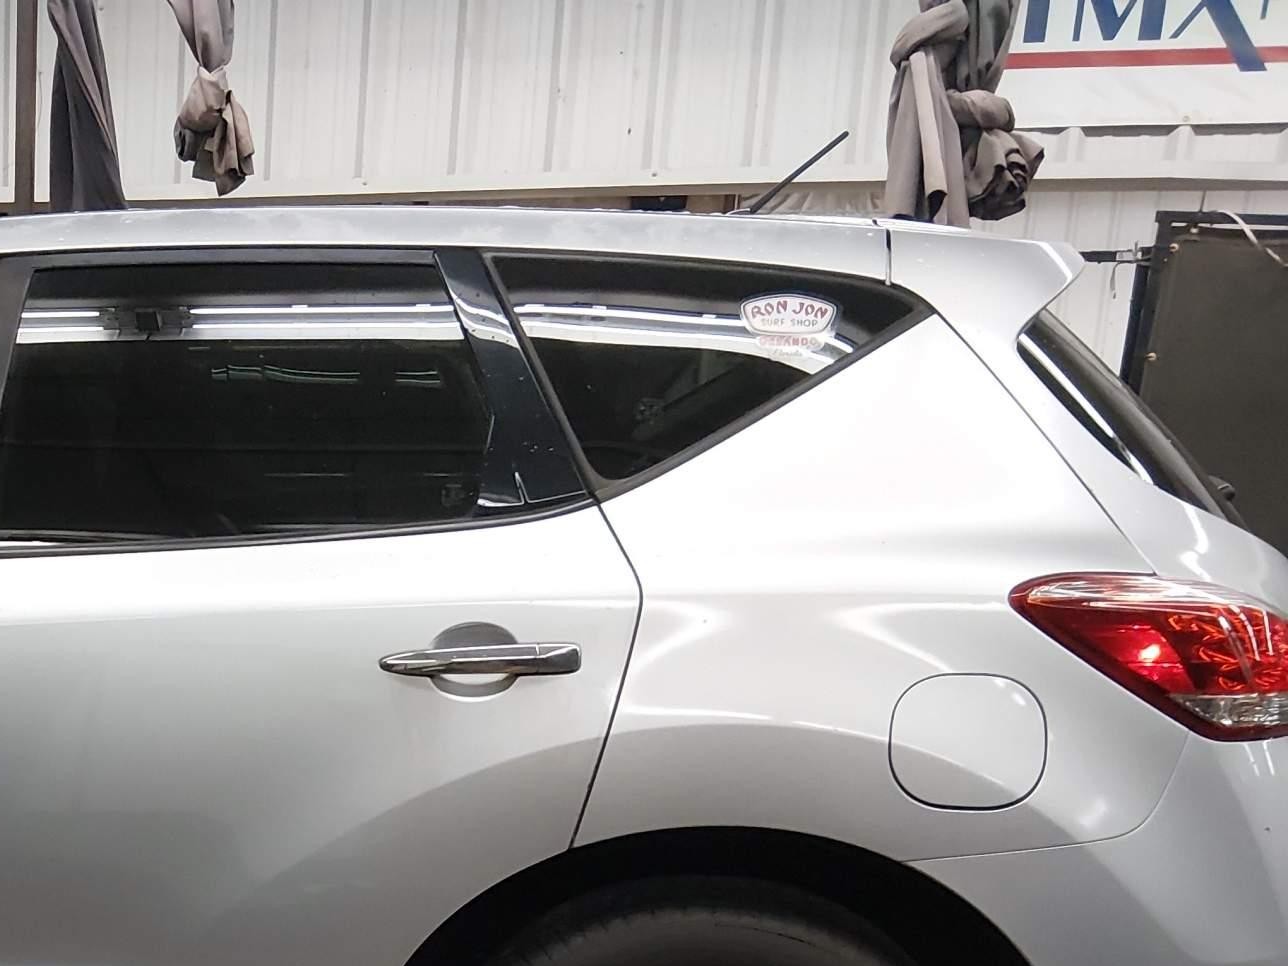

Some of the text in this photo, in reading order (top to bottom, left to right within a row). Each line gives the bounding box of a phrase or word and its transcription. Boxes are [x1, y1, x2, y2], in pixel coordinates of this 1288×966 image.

[751, 300, 829, 320] RON JON
[761, 319, 818, 328] SURF SHOP
